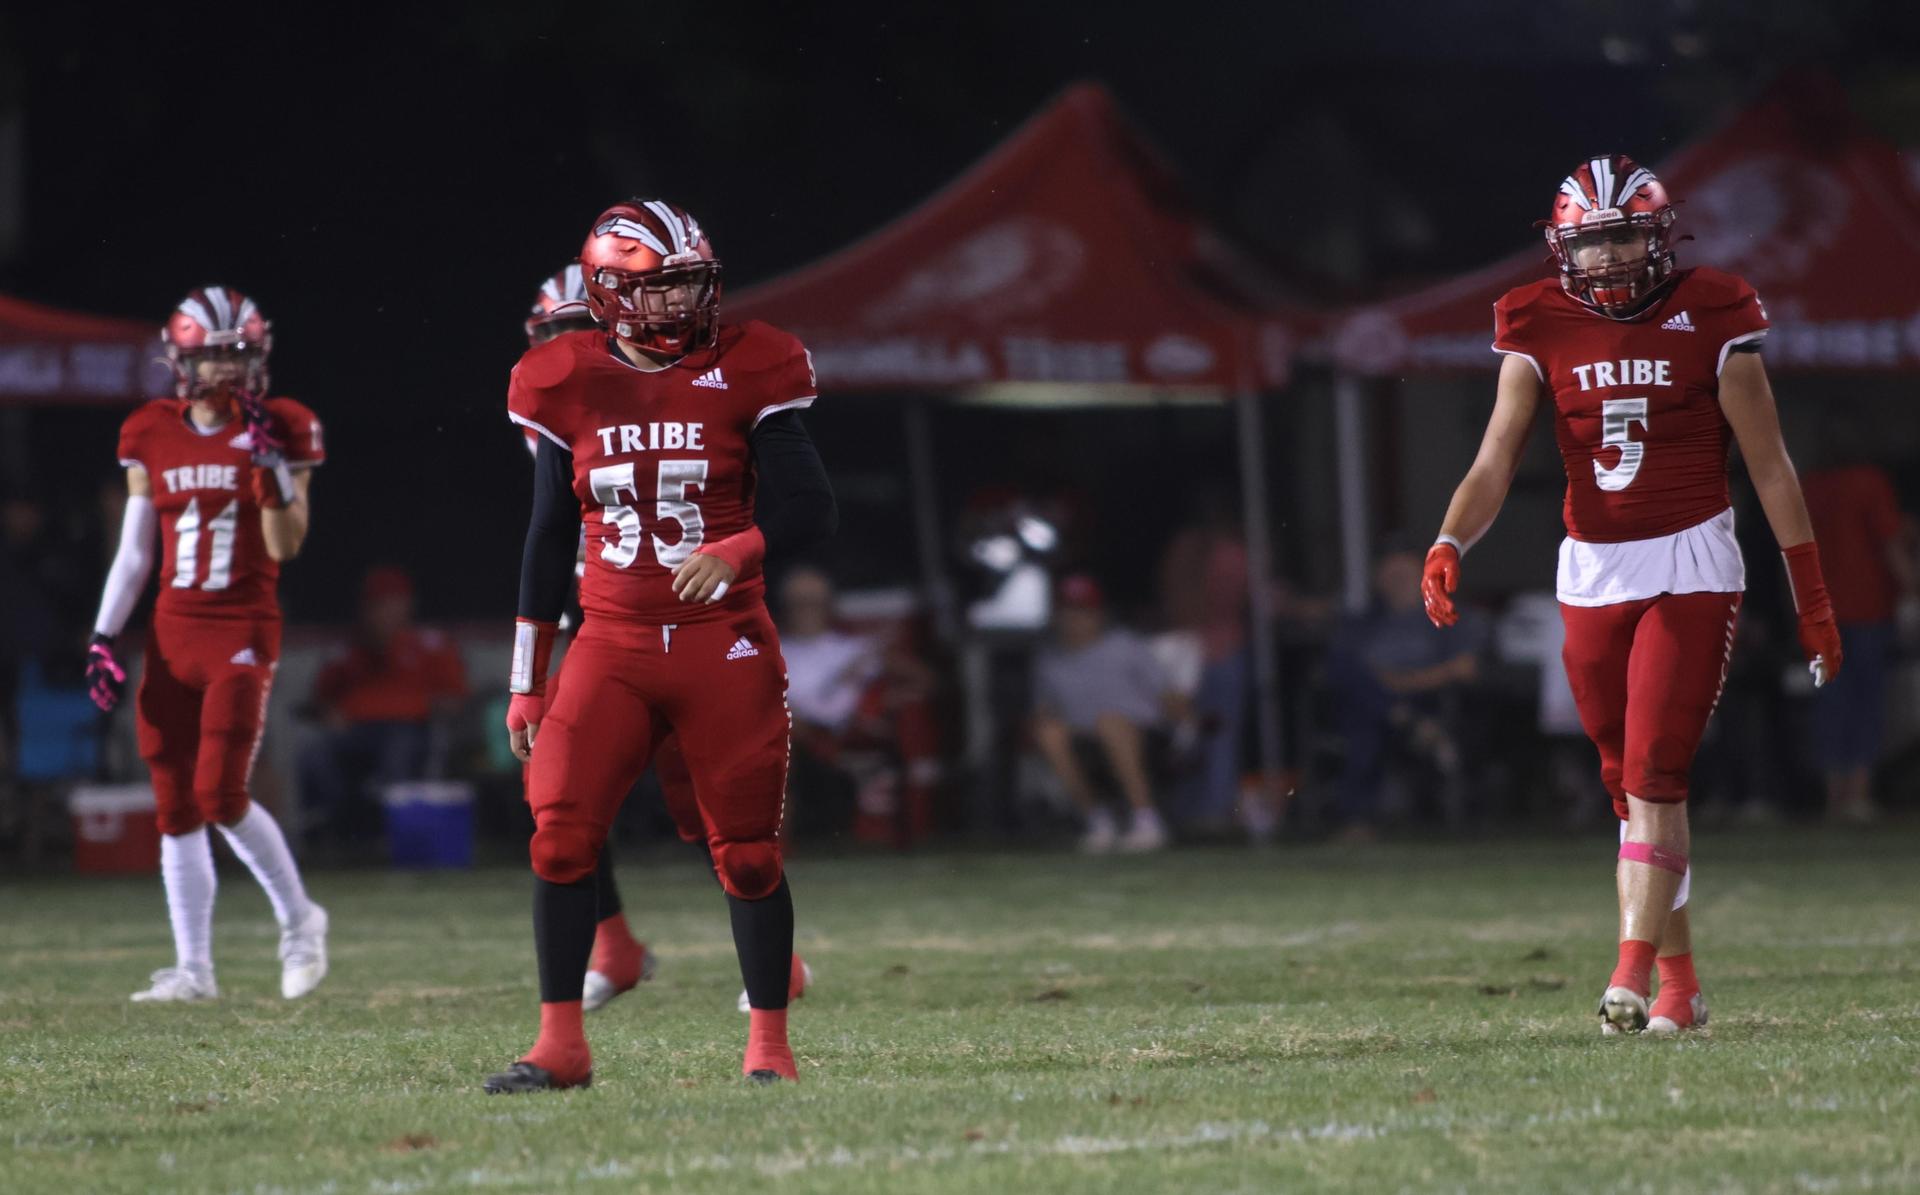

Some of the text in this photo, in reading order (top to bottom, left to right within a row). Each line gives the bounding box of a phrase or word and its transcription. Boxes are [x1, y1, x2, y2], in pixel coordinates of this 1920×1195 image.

[1660, 321, 1696, 332] adidas
[691, 378, 728, 390] adidas
[1572, 359, 1673, 391] TRIBE
[596, 422, 705, 456] TRIBE
[1592, 397, 1648, 491] 5
[162, 464, 239, 493] TRIBE
[589, 459, 709, 569] 55
[172, 497, 239, 590] 11
[726, 648, 759, 660] adidas
